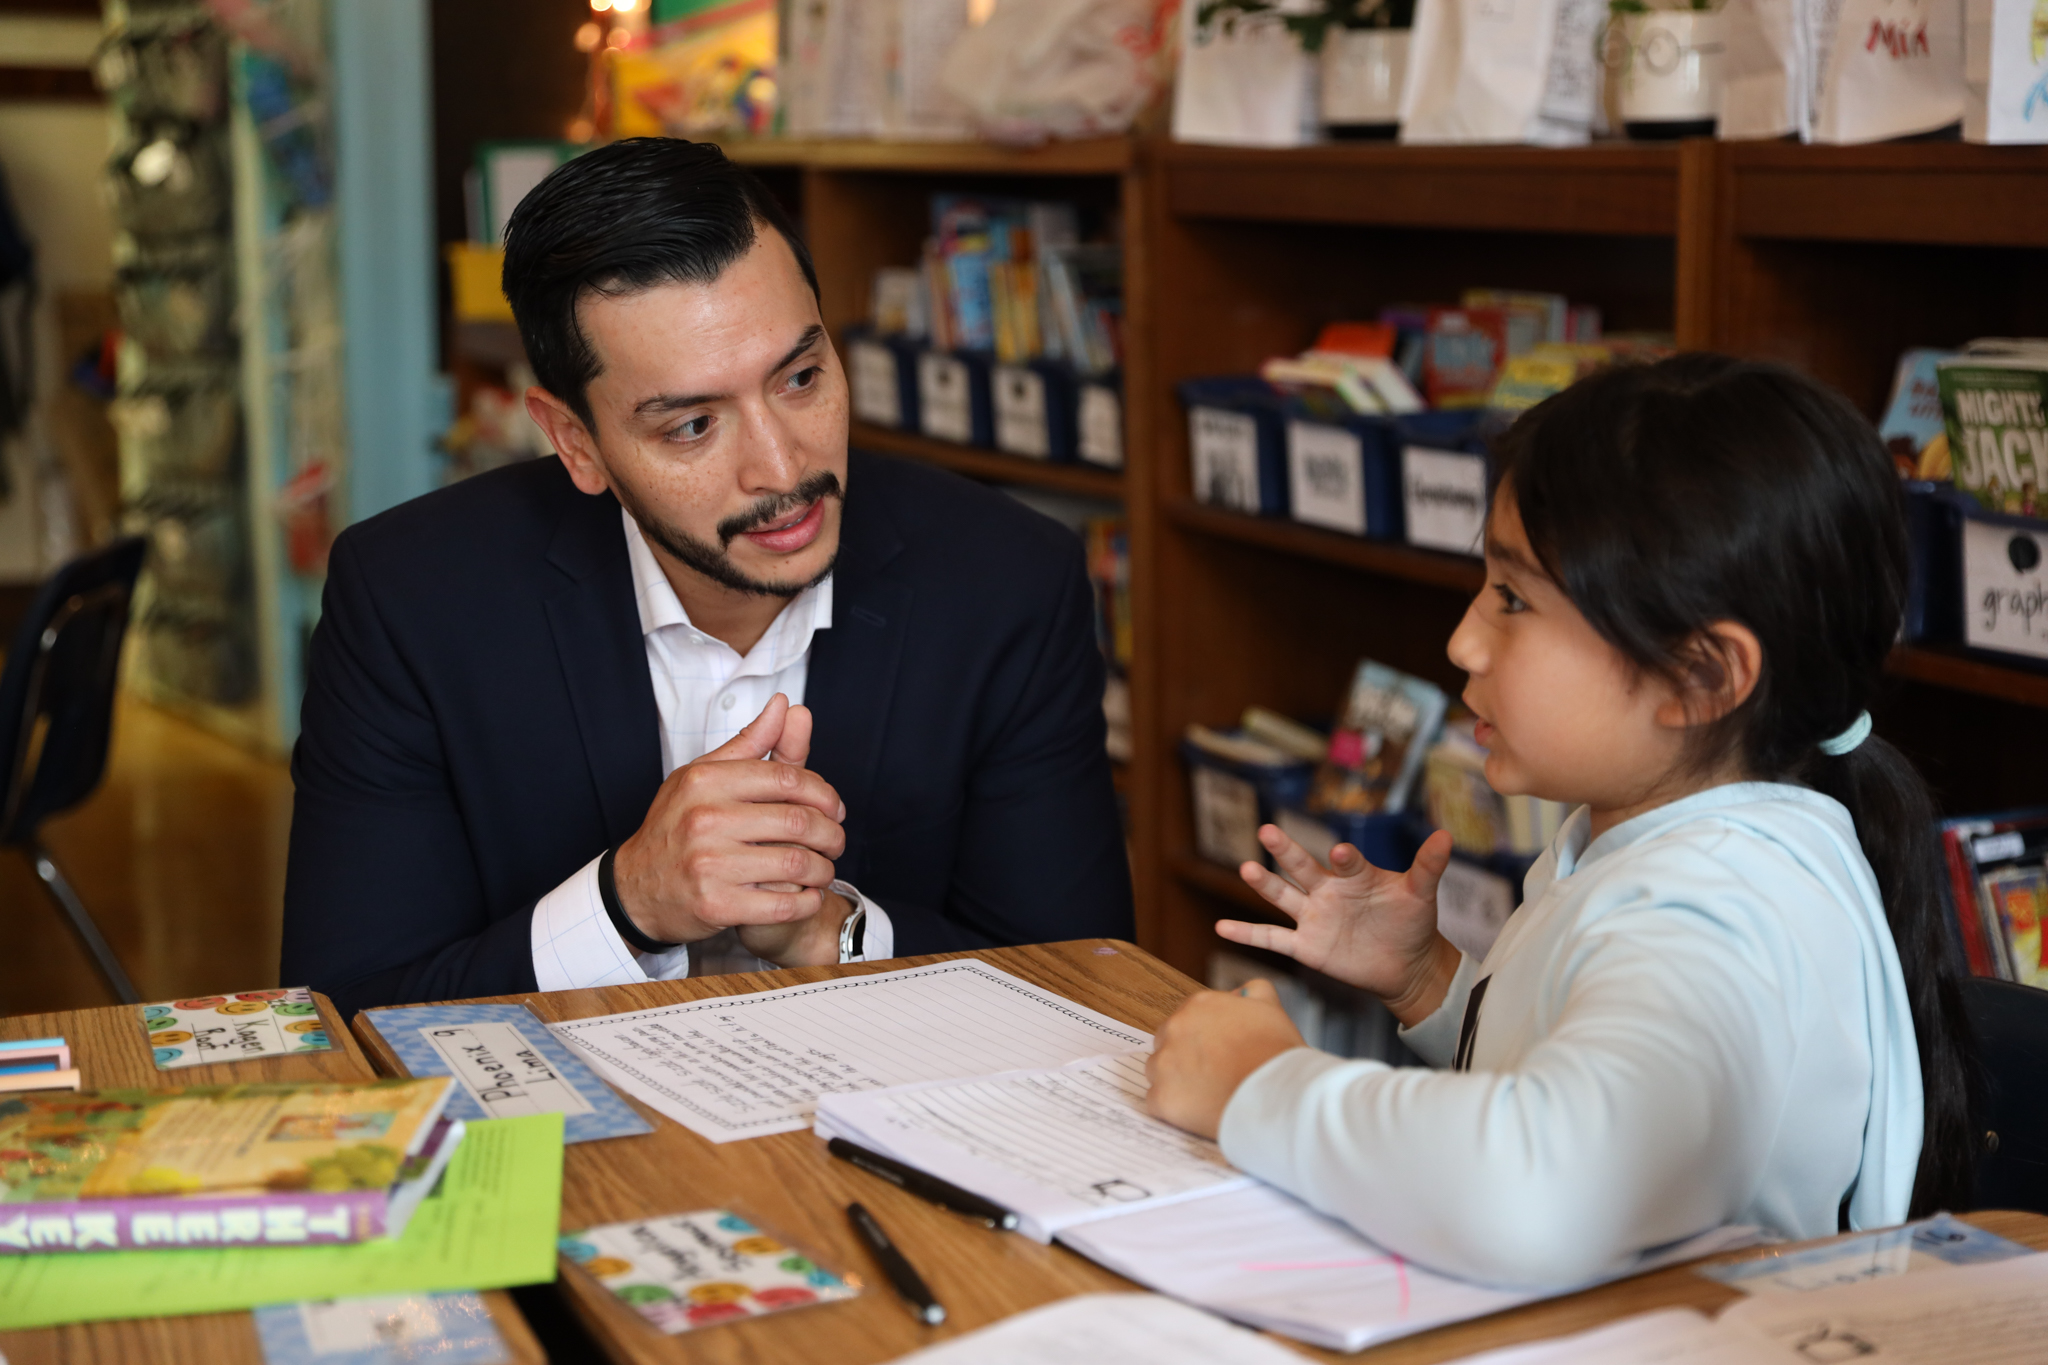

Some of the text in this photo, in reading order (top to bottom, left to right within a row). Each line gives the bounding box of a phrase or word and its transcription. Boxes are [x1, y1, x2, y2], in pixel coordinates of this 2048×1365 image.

[1955, 389, 2046, 427] MIGHTY
[462, 1043, 528, 1103] Phoenix
[515, 1048, 558, 1085] Lima
[131, 1205, 352, 1244] THREE
